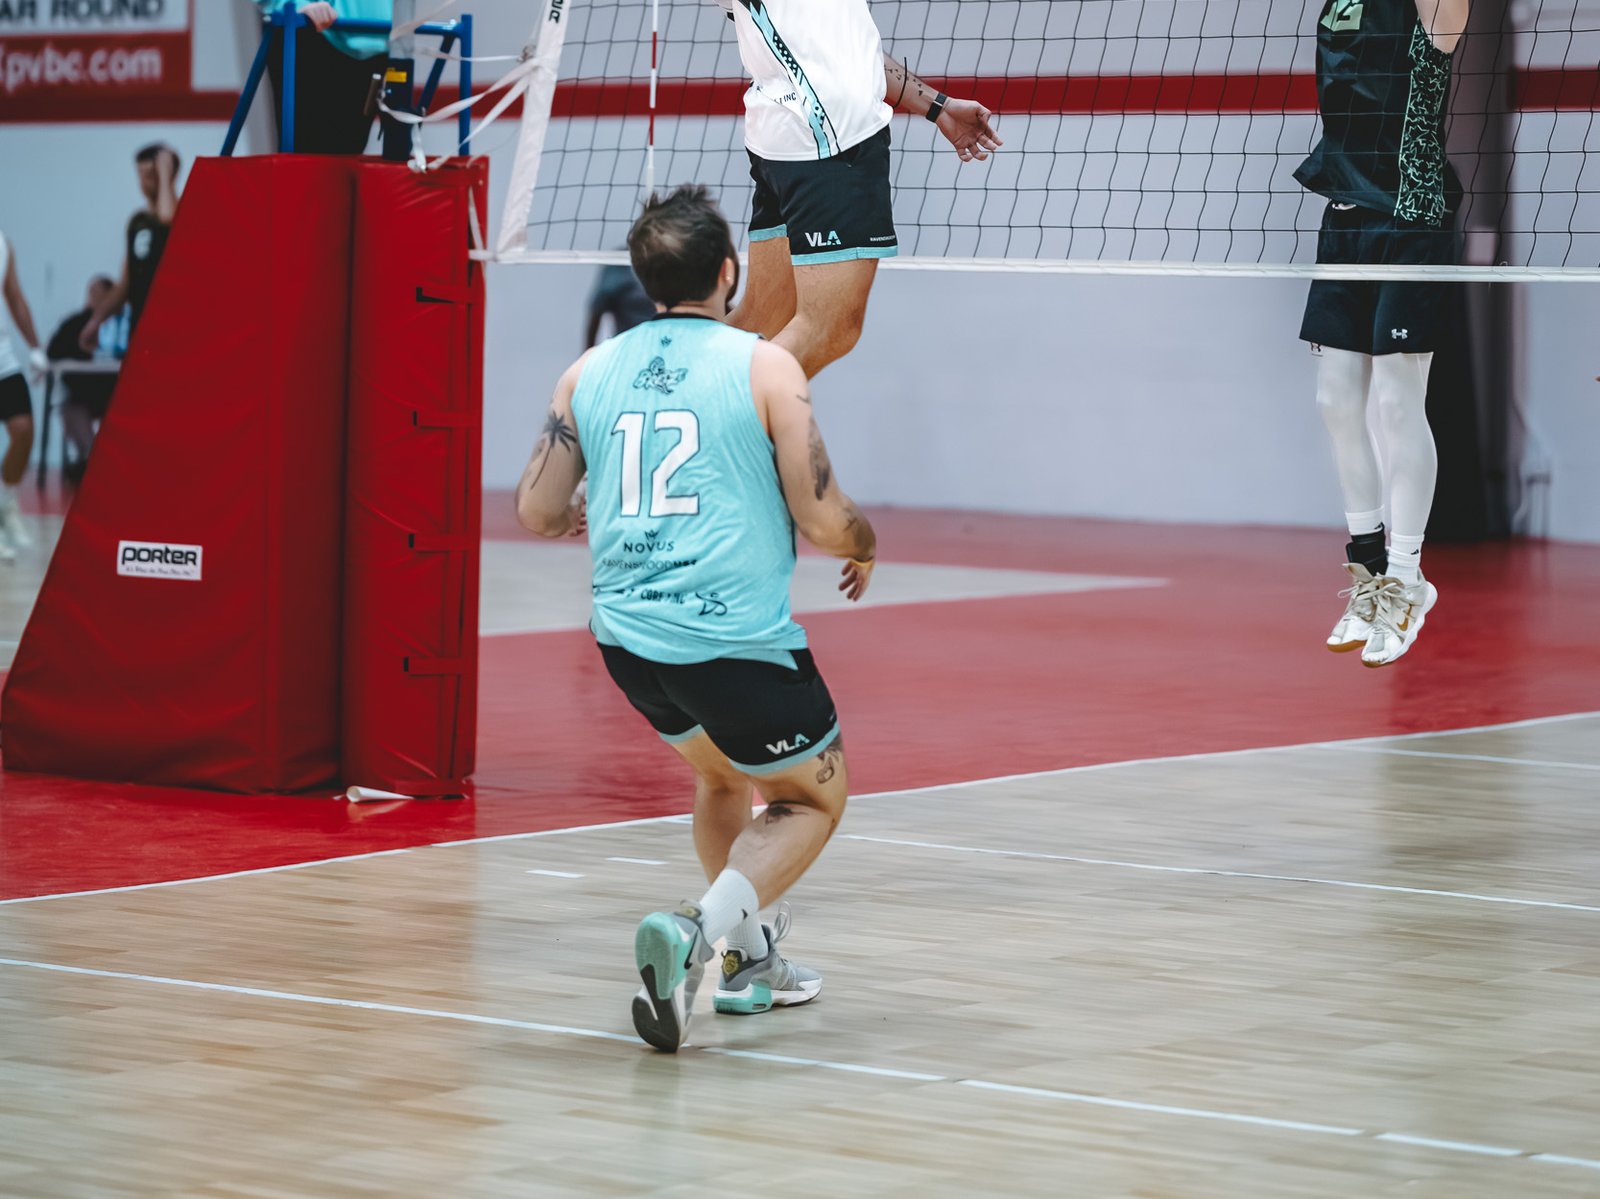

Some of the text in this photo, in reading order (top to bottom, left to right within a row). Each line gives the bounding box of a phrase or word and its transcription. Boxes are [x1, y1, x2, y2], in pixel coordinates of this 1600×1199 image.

[805, 230, 842, 247] VLA
[611, 409, 701, 517] 12
[623, 540, 675, 553] NOVUS
[766, 733, 811, 754] VLA
